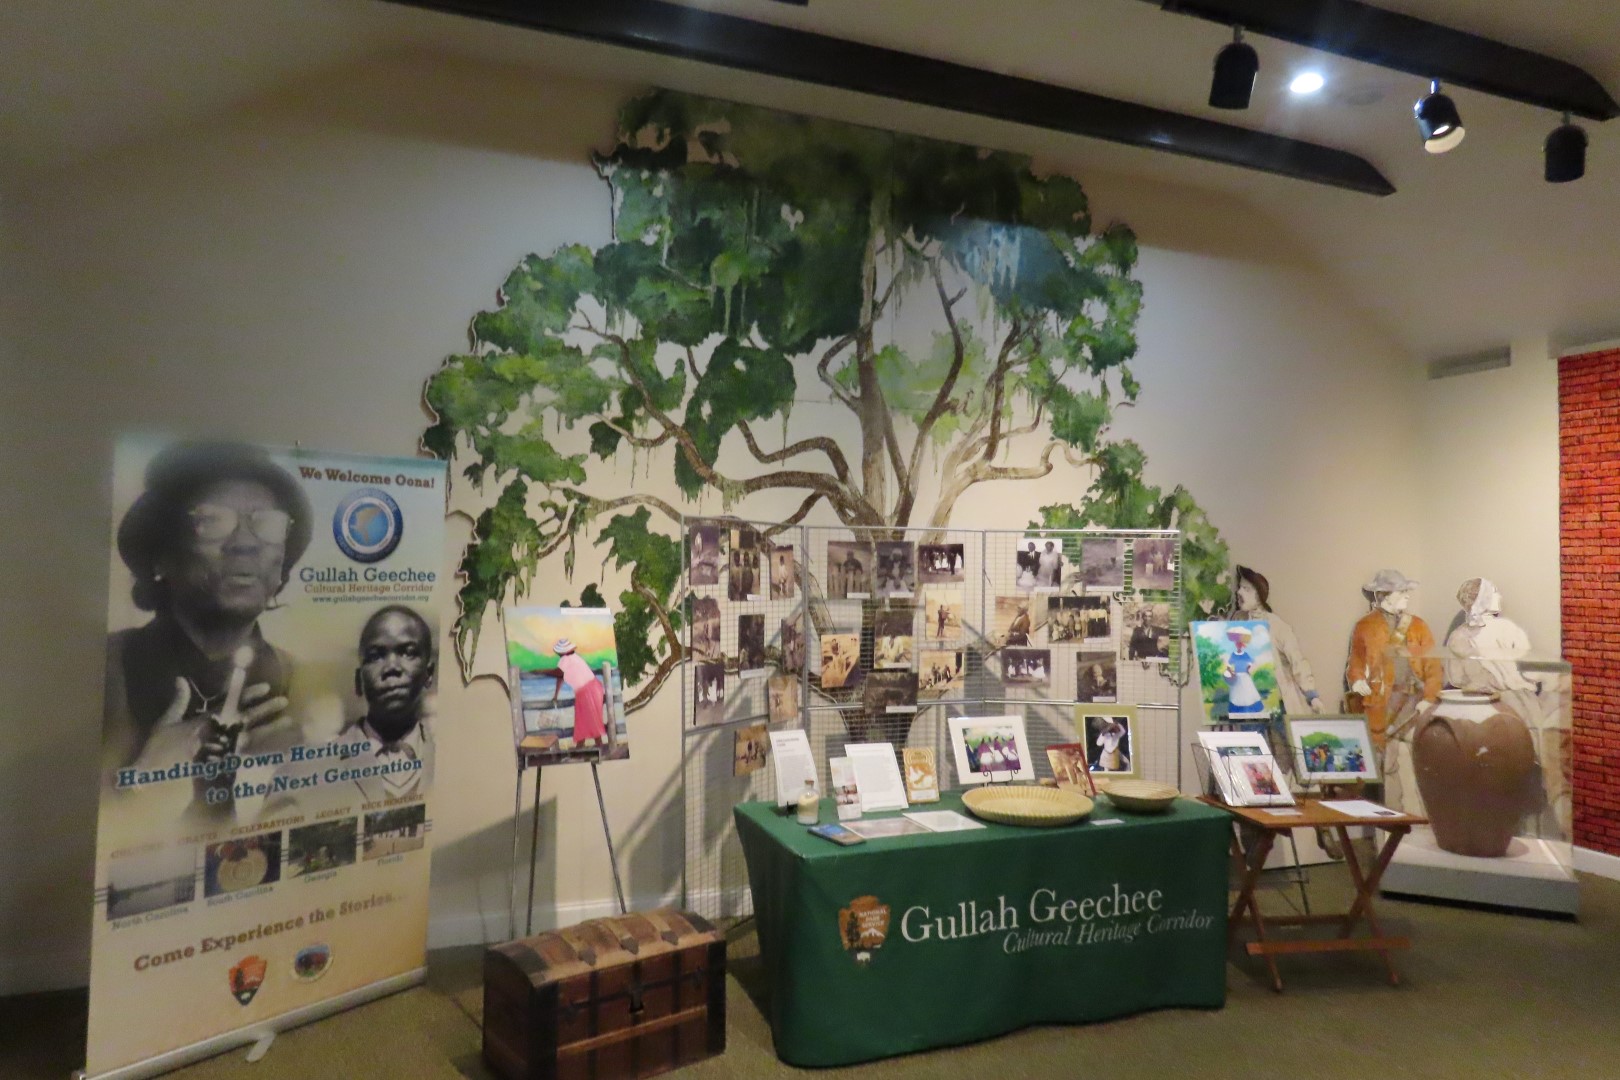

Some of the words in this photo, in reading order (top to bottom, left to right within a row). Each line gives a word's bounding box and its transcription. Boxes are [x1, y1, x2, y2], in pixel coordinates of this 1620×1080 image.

[299, 466, 322, 480] We
[325, 468, 391, 485] Welcome
[395, 474, 435, 489] Oona!
[299, 567, 359, 583] Gullah
[363, 567, 436, 582] Geechee
[304, 584, 346, 594] Cultural
[348, 583, 391, 595] Heritage
[393, 583, 433, 593] Corridor
[118, 762, 219, 787] Handing
[224, 752, 284, 772] Down
[290, 741, 372, 762] Heritage
[207, 787, 228, 804] to
[234, 782, 267, 799] the
[273, 773, 318, 793] Next
[324, 759, 423, 784] Generation
[316, 807, 352, 820] LEGACY
[230, 815, 305, 836] CELEBRATIONS
[235, 886, 274, 900] Carolina
[112, 918, 142, 930] North
[145, 906, 189, 921] Carolina
[901, 895, 1020, 943] Gullah
[1029, 883, 1163, 923] Geechee
[134, 946, 195, 971] Come
[201, 916, 304, 953] Experience
[309, 908, 336, 924] the
[1003, 925, 1072, 955] Cultural
[1076, 919, 1142, 944] Heritage
[1146, 908, 1215, 934] Corridor
